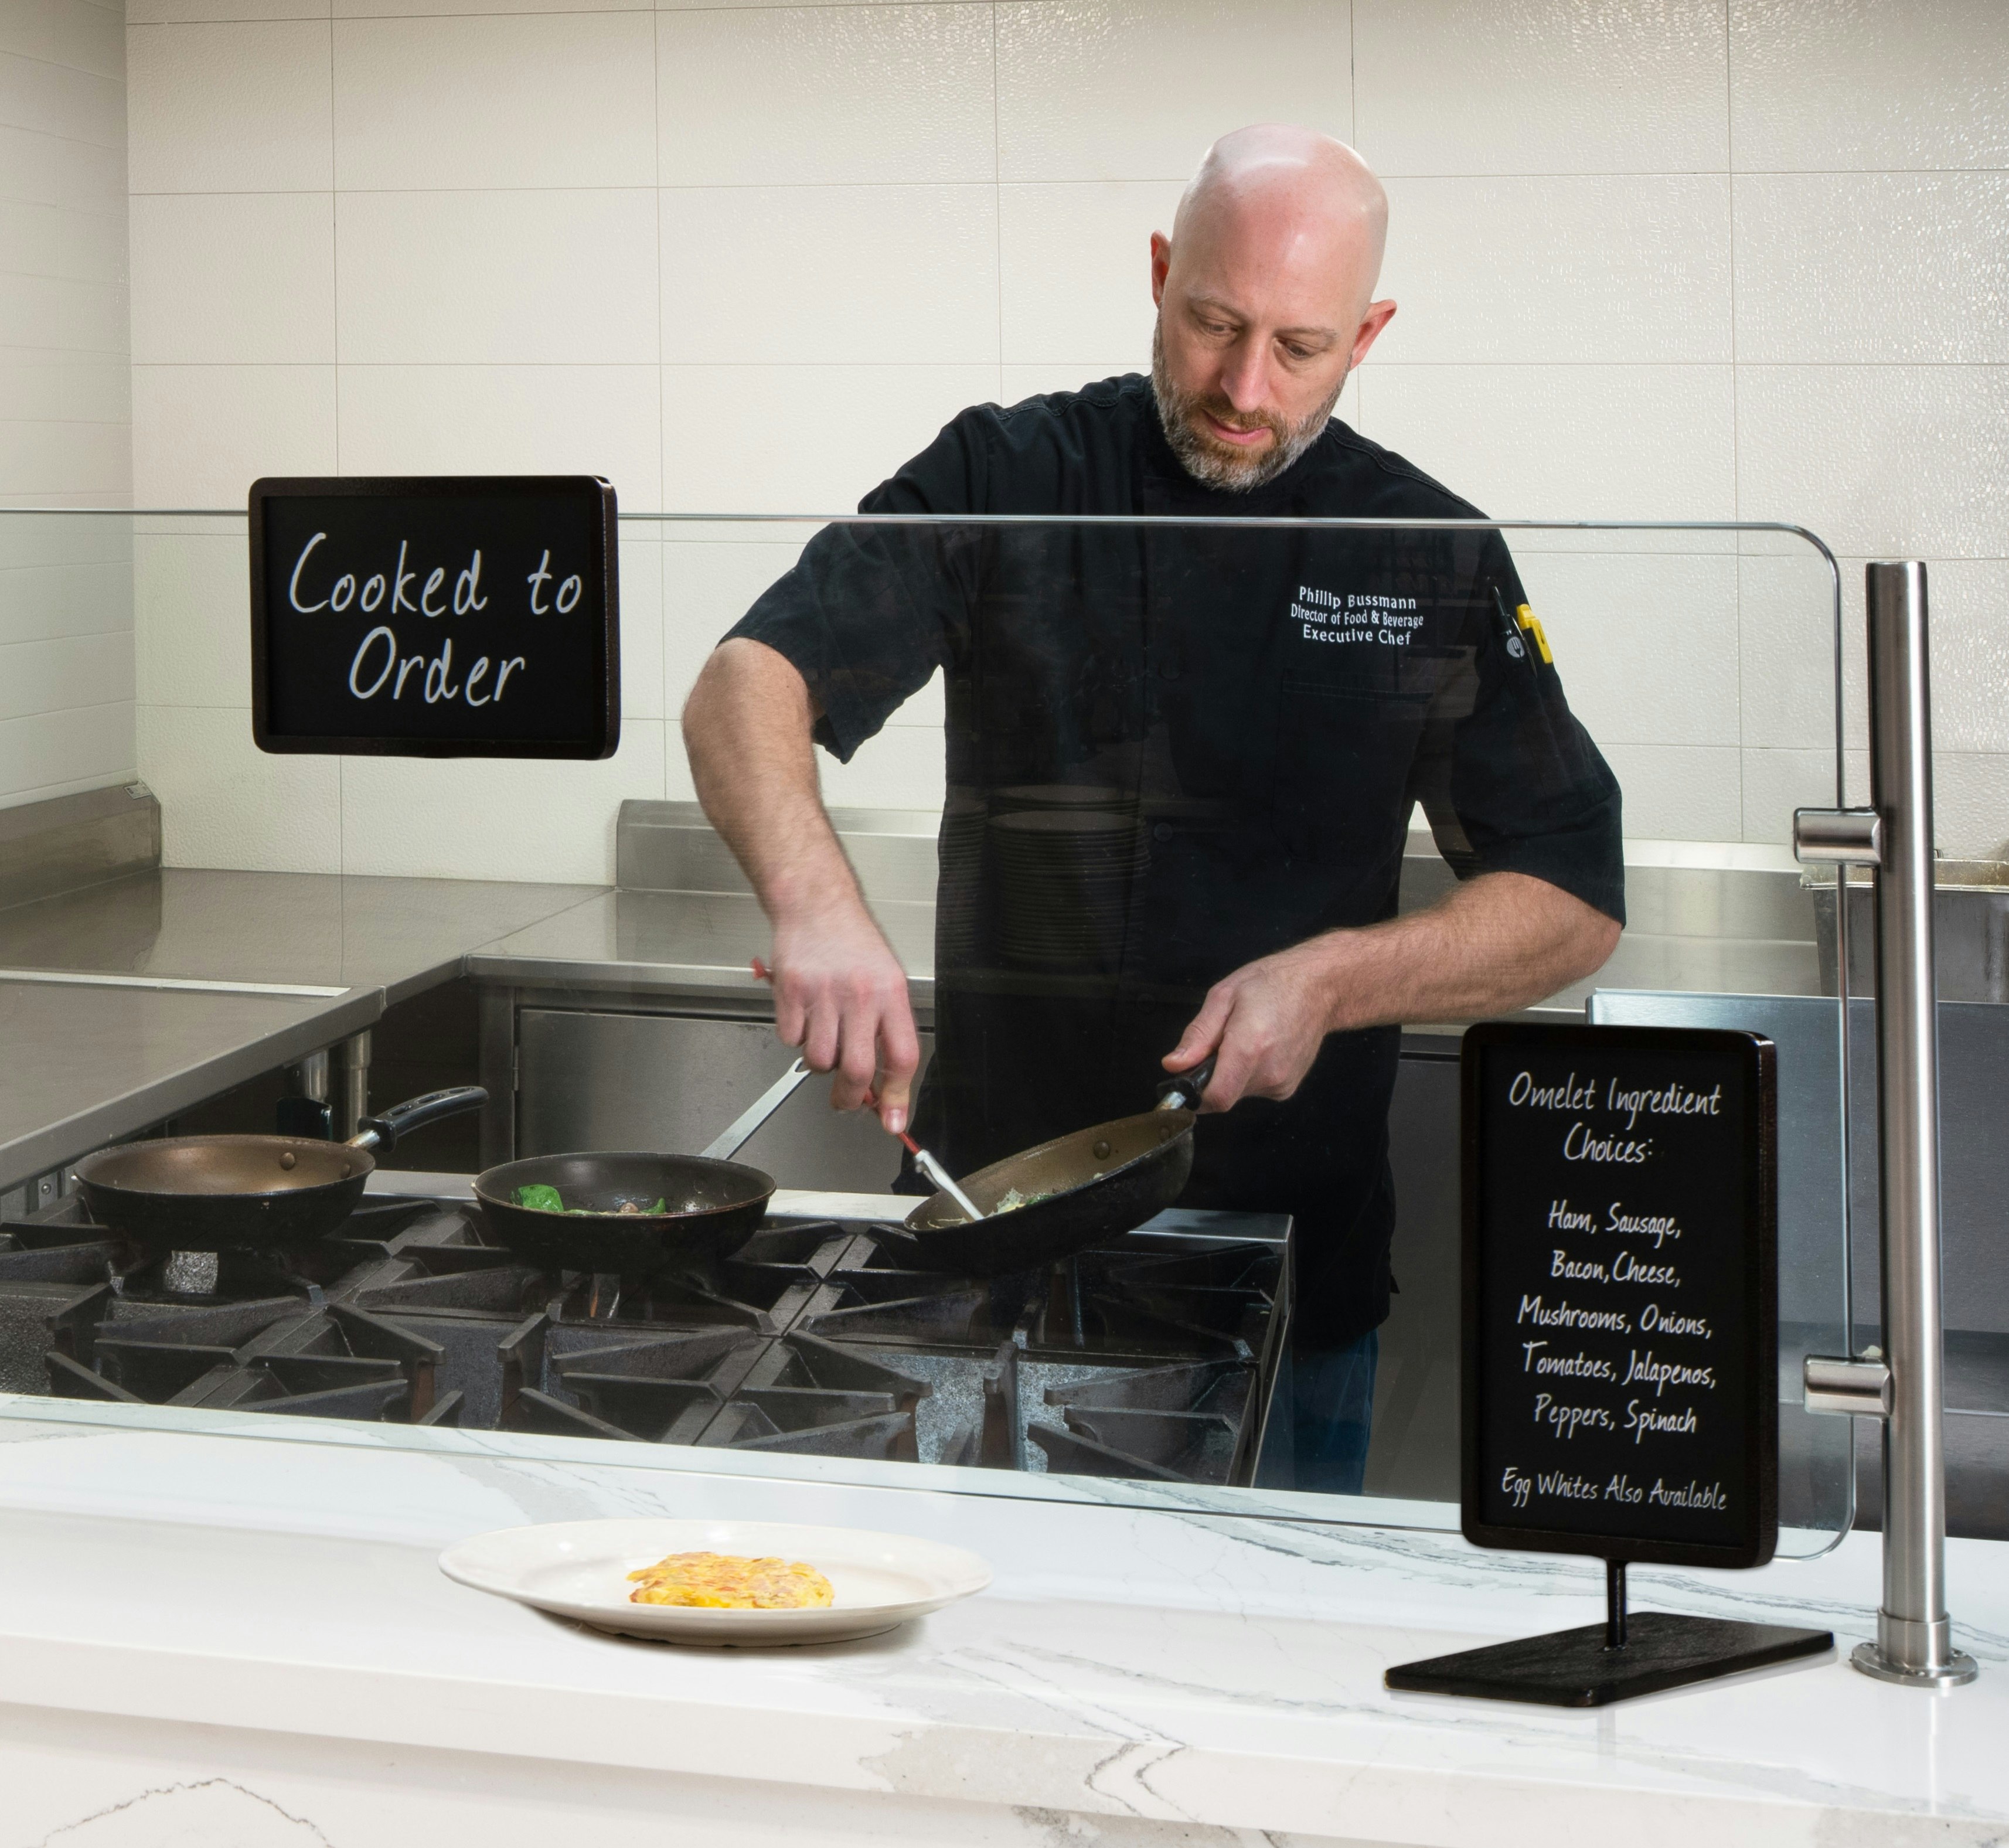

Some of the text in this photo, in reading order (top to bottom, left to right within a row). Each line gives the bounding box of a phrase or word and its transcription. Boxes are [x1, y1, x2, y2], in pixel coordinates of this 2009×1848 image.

[290, 532, 581, 617] Cooked to
[1290, 604, 1424, 629] Director of Food & Beverage
[1299, 586, 1416, 610] Phillip Bussmann
[1303, 624, 1411, 645] Executive Chef
[349, 626, 525, 706] Order
[1509, 1071, 1721, 1131] Omelet Ingredient
[1564, 1122, 1653, 1163] Choices:
[1548, 1199, 1681, 1249] Ham, Sausage,
[1551, 1250, 1680, 1288] Bacon, Cheese,
[1517, 1294, 1711, 1339] Mushrooms, Onions,
[1523, 1341, 1716, 1397] Tomatoes, Jalapenos,
[1535, 1393, 1697, 1444] Peppers, Spinach
[1501, 1467, 1726, 1510] Egg Whites Also Available
